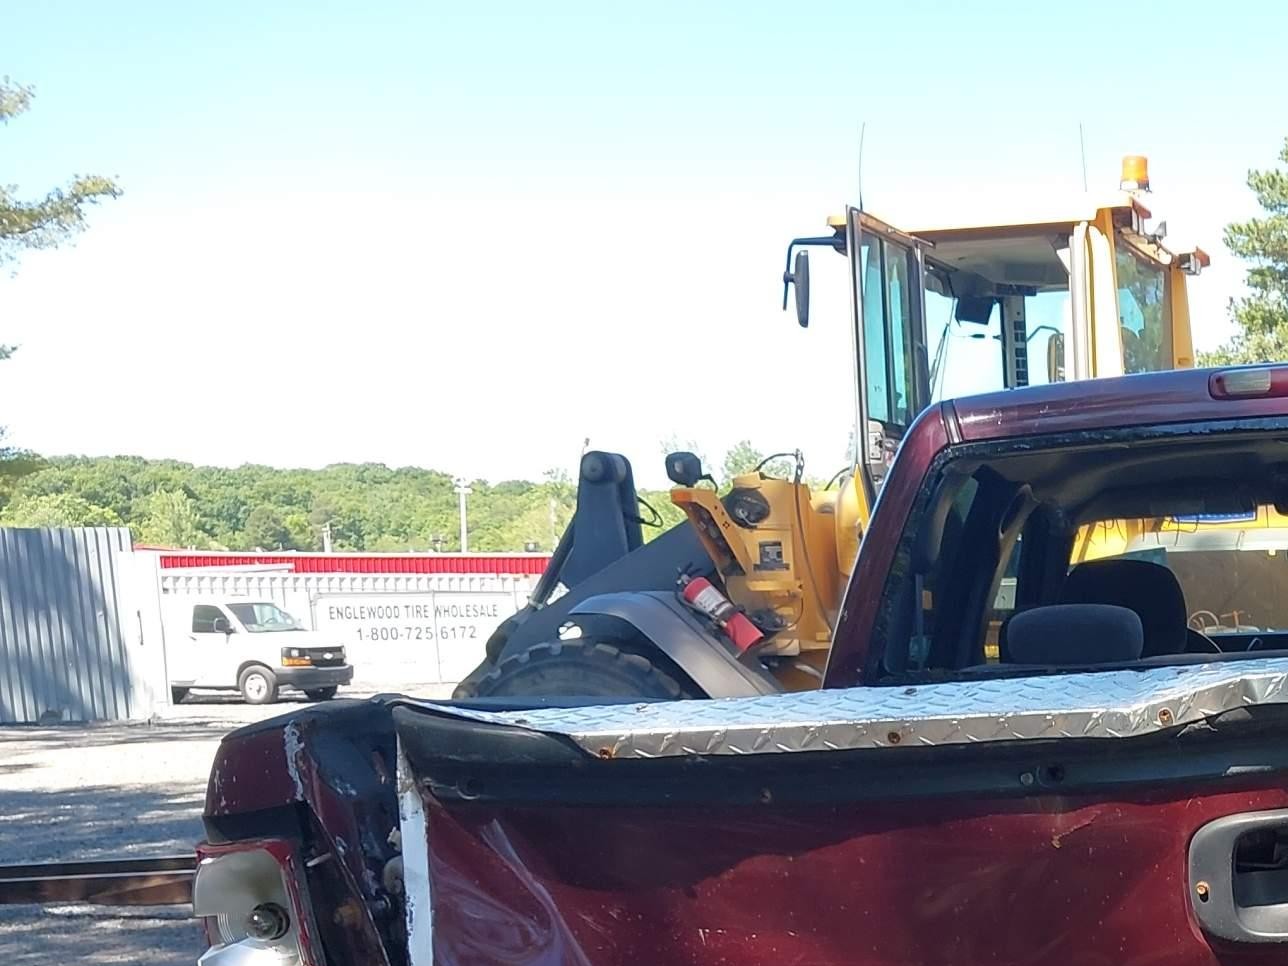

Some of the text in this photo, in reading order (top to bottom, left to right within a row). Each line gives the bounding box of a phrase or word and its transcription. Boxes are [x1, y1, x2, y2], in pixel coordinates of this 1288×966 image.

[329, 604, 498, 620] ENGLEWOOD TIRE WHOLESALE
